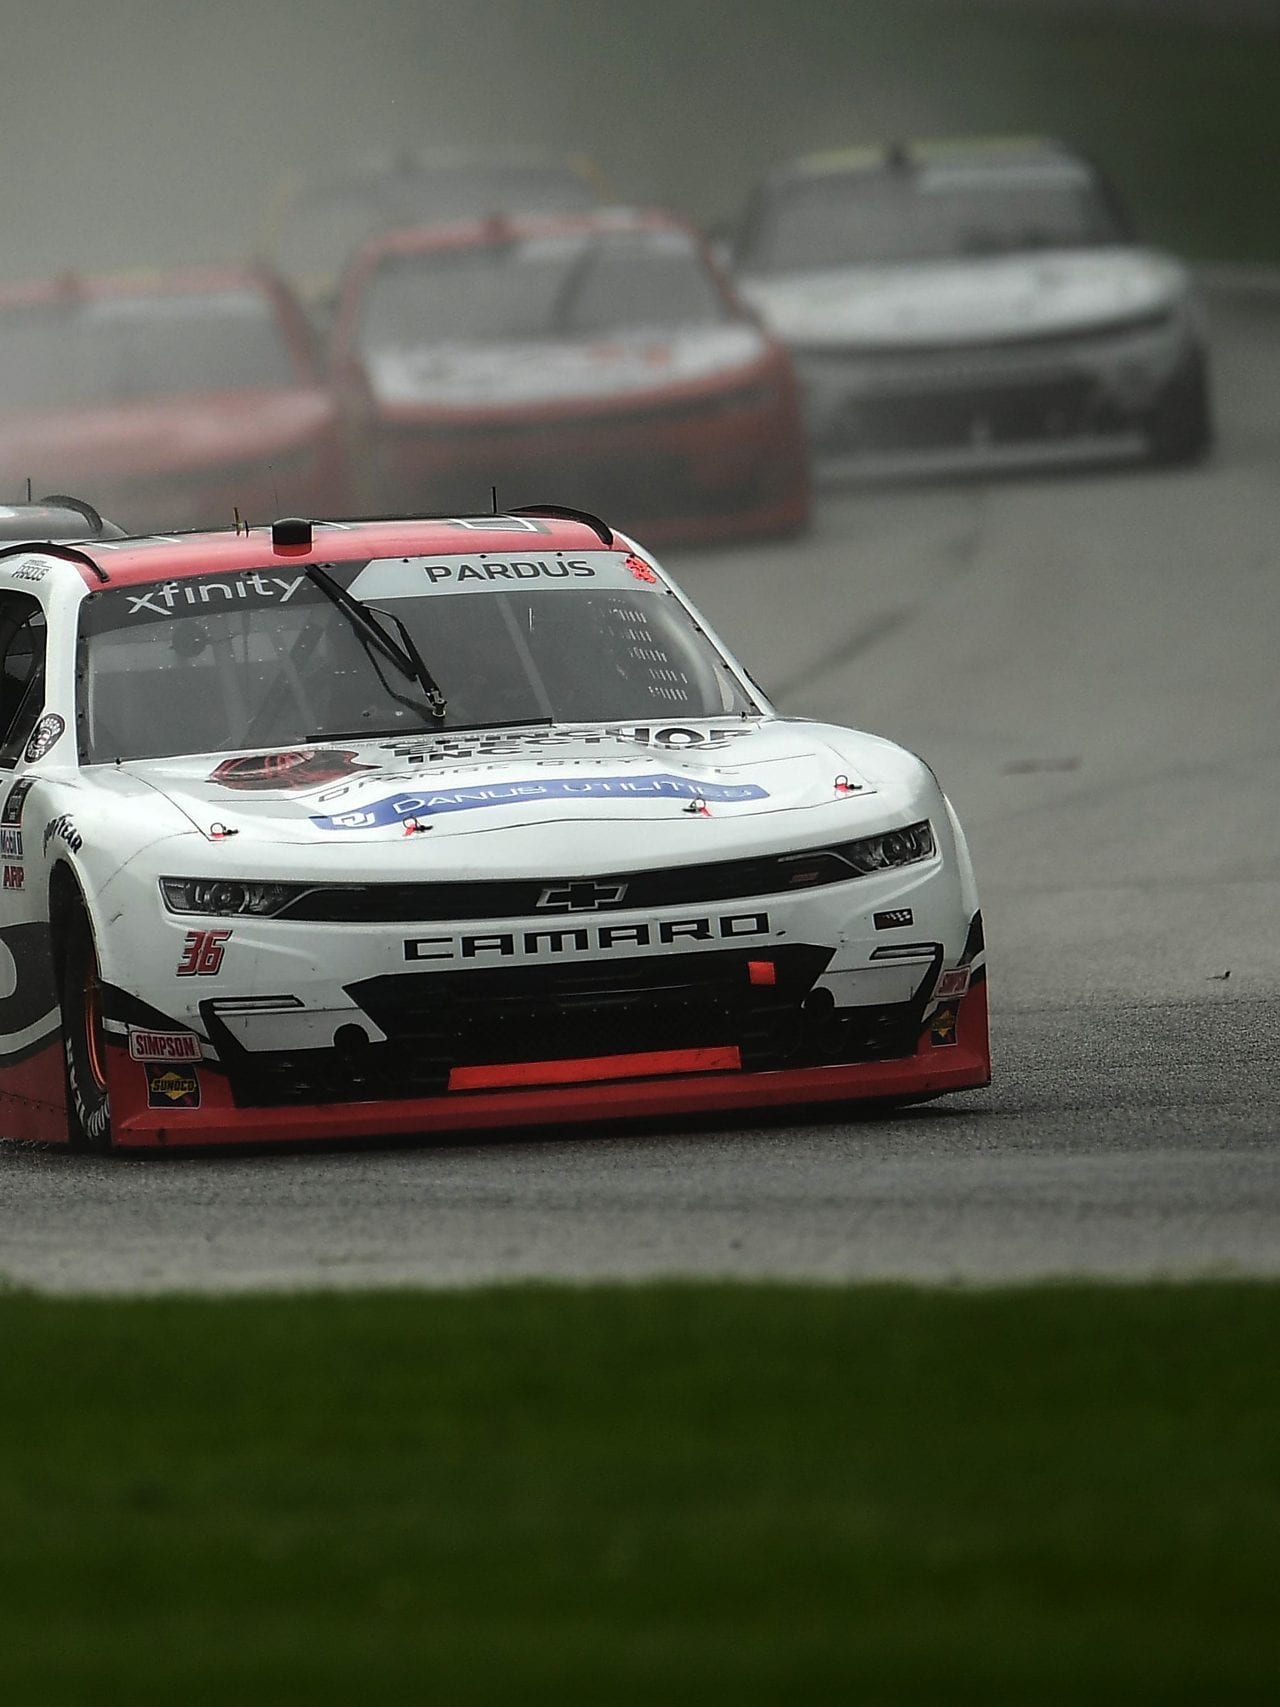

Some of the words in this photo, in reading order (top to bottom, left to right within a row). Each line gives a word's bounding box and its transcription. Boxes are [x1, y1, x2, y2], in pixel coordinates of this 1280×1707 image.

[425, 560, 596, 583] PARDUS
[126, 574, 305, 616] xfinity
[393, 783, 548, 813] DANUS
[3, 866, 24, 888] ARP
[404, 912, 770, 960] CAMARO
[176, 930, 233, 976] 36
[136, 1034, 196, 1057] SIMPSON
[150, 1078, 197, 1093] SUNOCO
